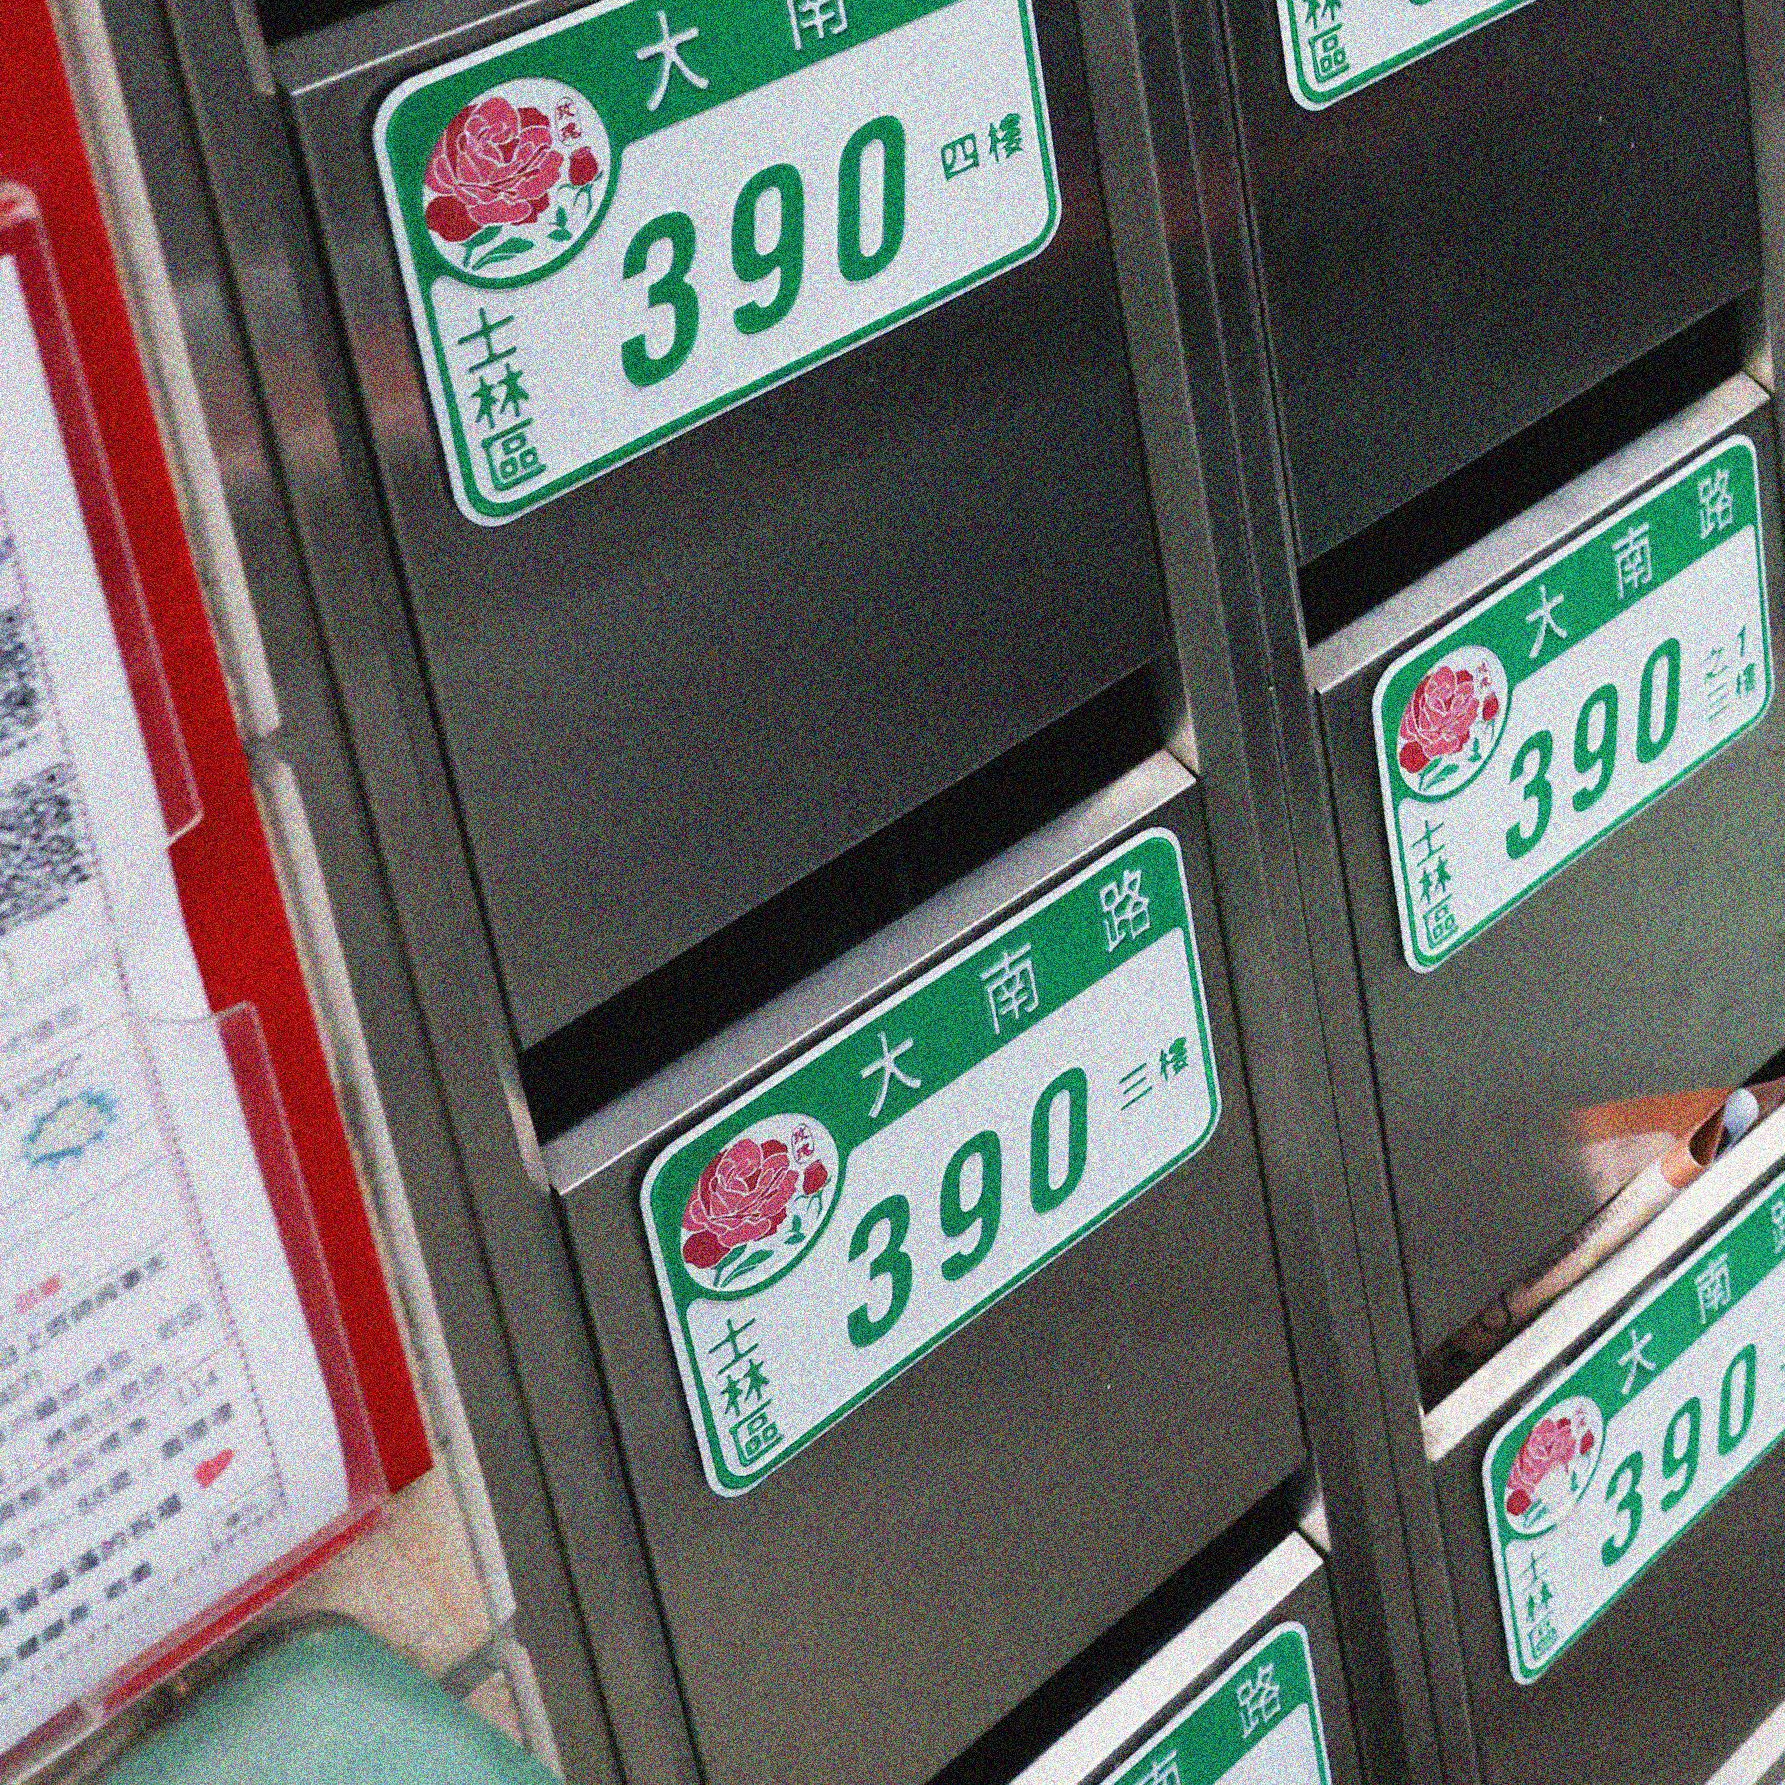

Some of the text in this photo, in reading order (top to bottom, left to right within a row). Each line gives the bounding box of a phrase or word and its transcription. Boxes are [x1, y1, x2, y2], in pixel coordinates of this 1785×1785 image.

[938, 111, 1025, 180] 四樓
[621, 113, 908, 389] 390
[456, 308, 547, 493] 士林區
[1524, 468, 1737, 661] 大南路
[1505, 636, 1681, 862] 390
[1411, 819, 1459, 948] 士林區
[859, 867, 1154, 1121] 大南路
[1119, 1034, 1190, 1112] 三樓
[846, 1066, 1088, 1350] 390
[706, 1315, 784, 1470] 士林區
[1599, 1340, 1758, 1568] 390
